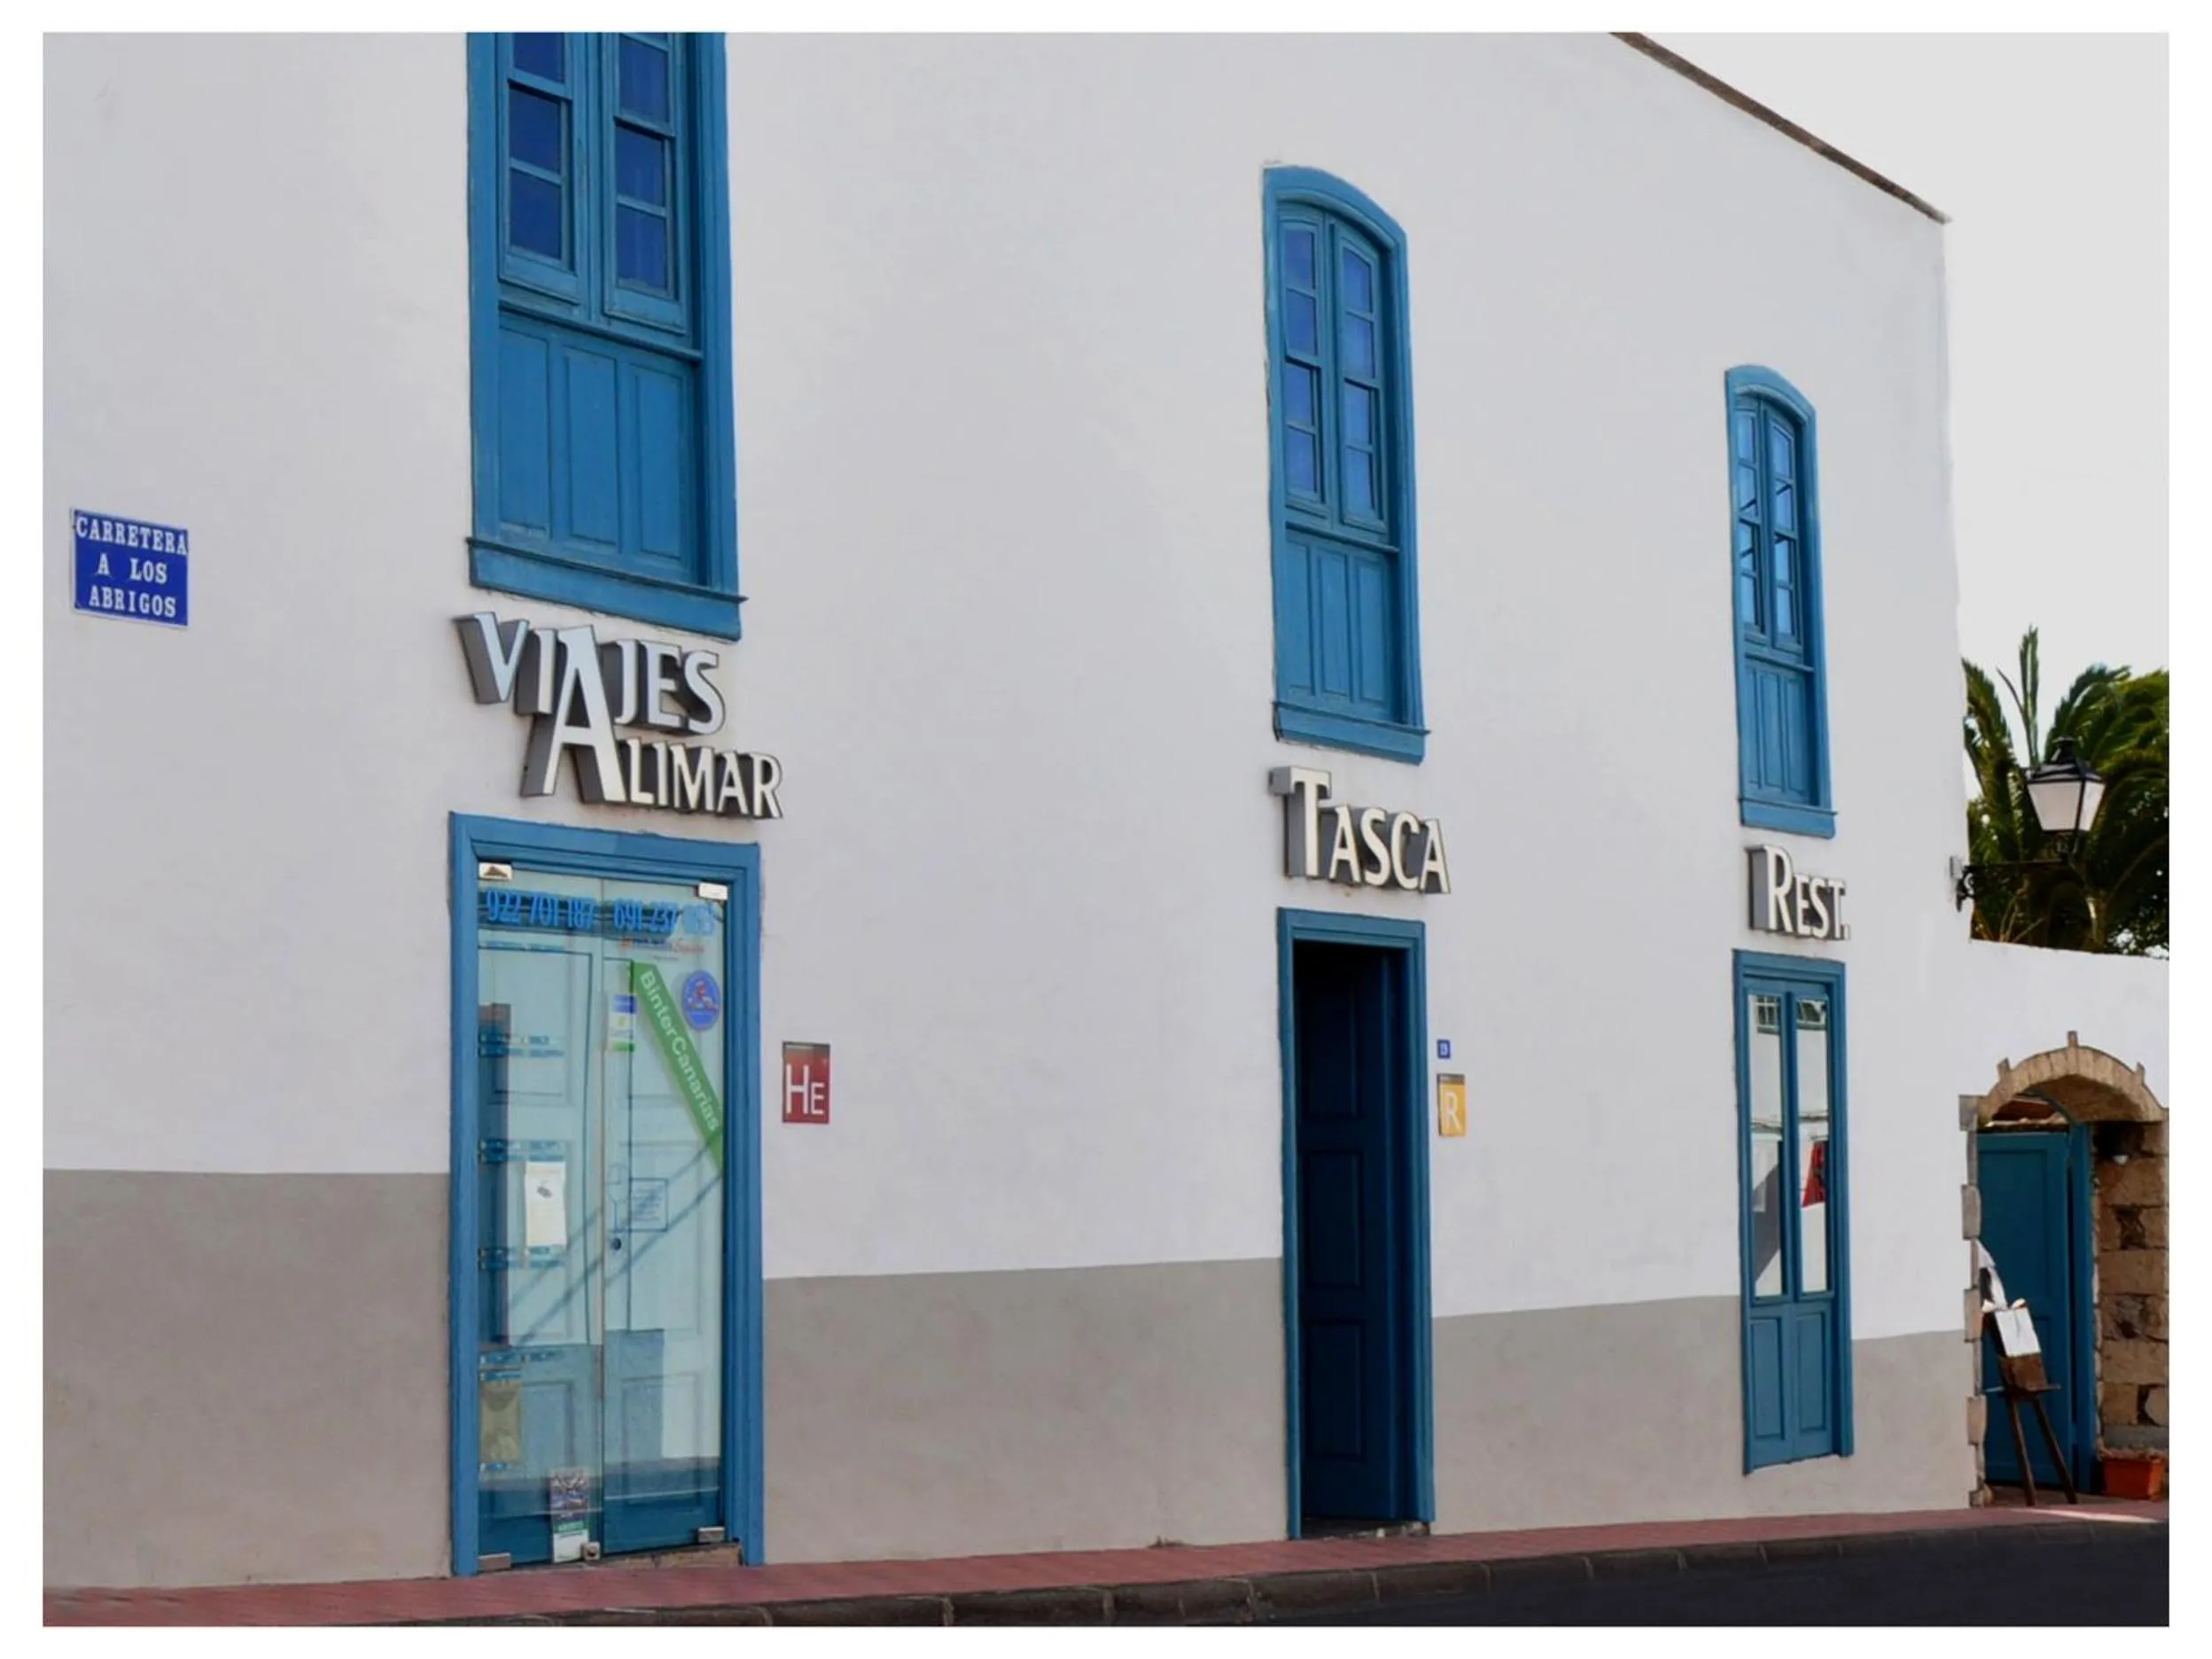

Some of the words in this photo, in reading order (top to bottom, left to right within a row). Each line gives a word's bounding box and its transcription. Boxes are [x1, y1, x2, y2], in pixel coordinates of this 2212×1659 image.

[76, 517, 189, 556] CARRETERA
[97, 552, 110, 576] A
[129, 557, 167, 585] LOS
[89, 585, 176, 618] ABRIGOS
[456, 611, 726, 736] VIAJES
[521, 625, 783, 818] ALIMAR
[1269, 766, 1451, 895] TASCA
[1745, 844, 1850, 941] REST.
[1443, 1090, 1464, 1134] R
